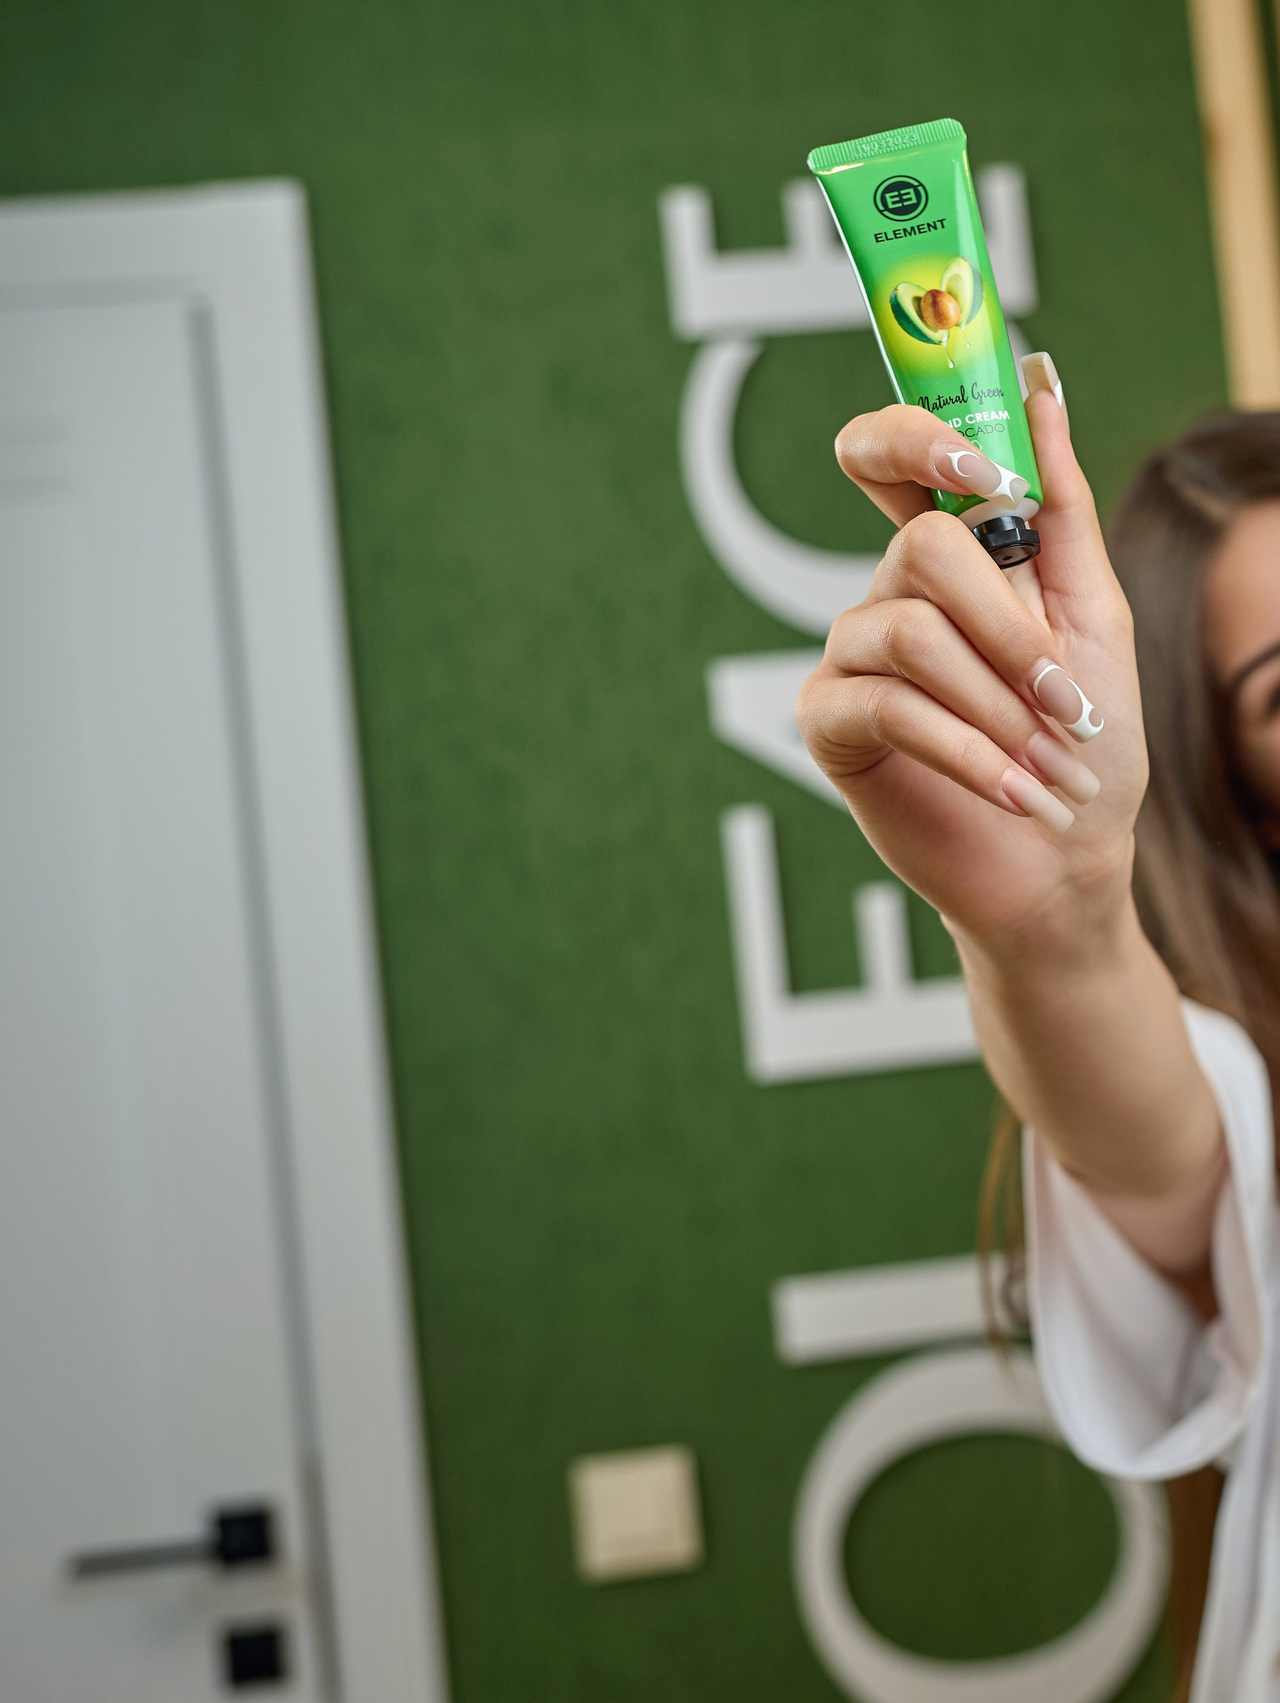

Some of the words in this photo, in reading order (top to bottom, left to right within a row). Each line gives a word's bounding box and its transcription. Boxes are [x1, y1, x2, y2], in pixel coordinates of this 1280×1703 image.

[874, 218, 946, 243] ELEMENT
[917, 385, 969, 413] Natural
[970, 382, 1004, 405] Green
[946, 417, 962, 429] ND
[965, 410, 1010, 424] CREAM
